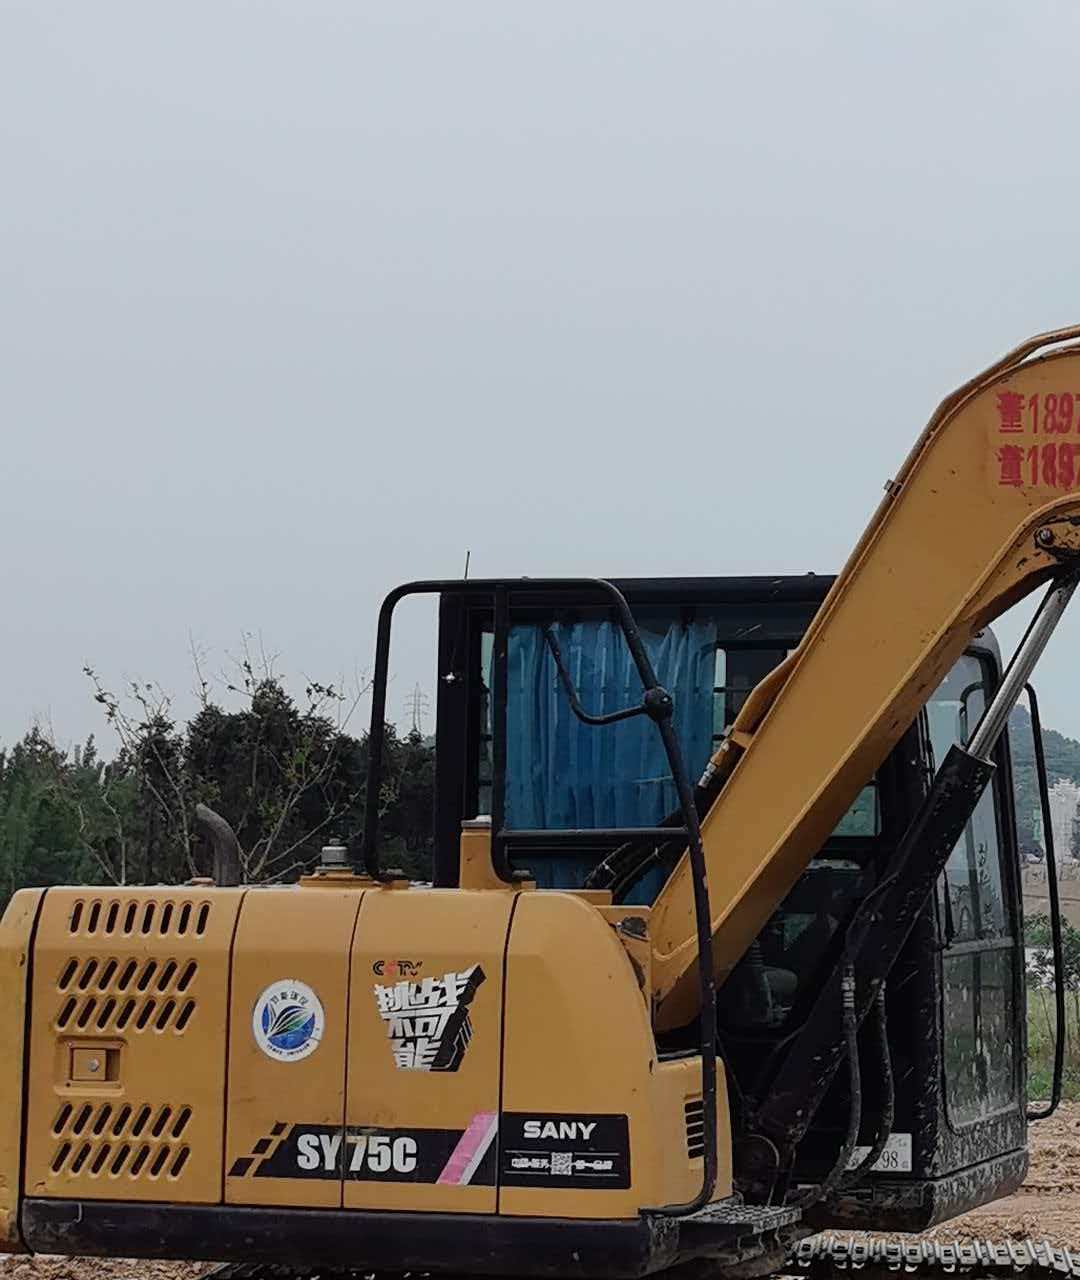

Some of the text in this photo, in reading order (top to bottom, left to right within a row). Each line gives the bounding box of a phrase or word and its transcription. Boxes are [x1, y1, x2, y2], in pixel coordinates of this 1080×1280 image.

[374, 963, 480, 1012] 挑战
[381, 1006, 458, 1040] 不可
[392, 1037, 442, 1069] 能
[523, 1120, 597, 1140] SANY
